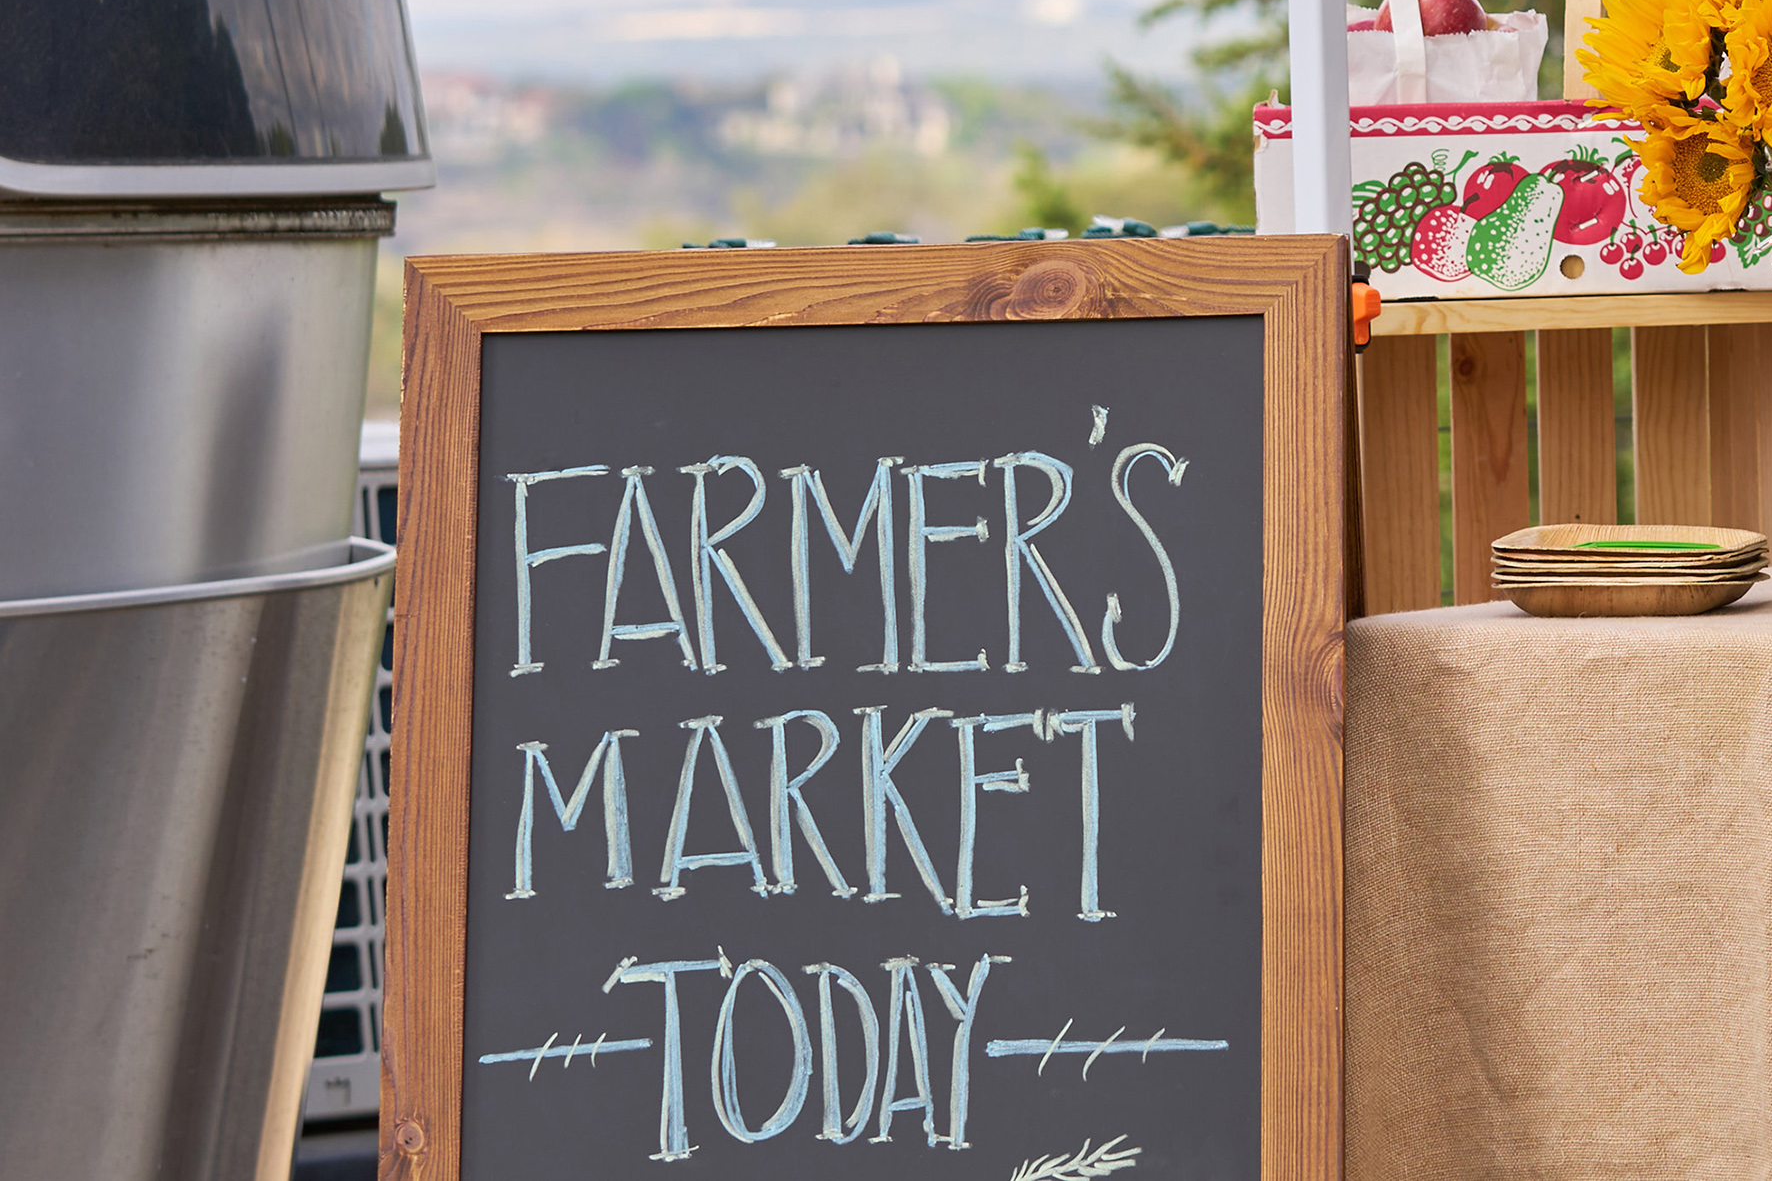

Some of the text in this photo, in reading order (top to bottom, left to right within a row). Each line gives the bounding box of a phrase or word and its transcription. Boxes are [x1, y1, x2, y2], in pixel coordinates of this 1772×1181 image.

[503, 404, 1190, 676] FARMER'S
[503, 703, 1137, 921] MARKET
[602, 944, 1013, 1161] TODAY
